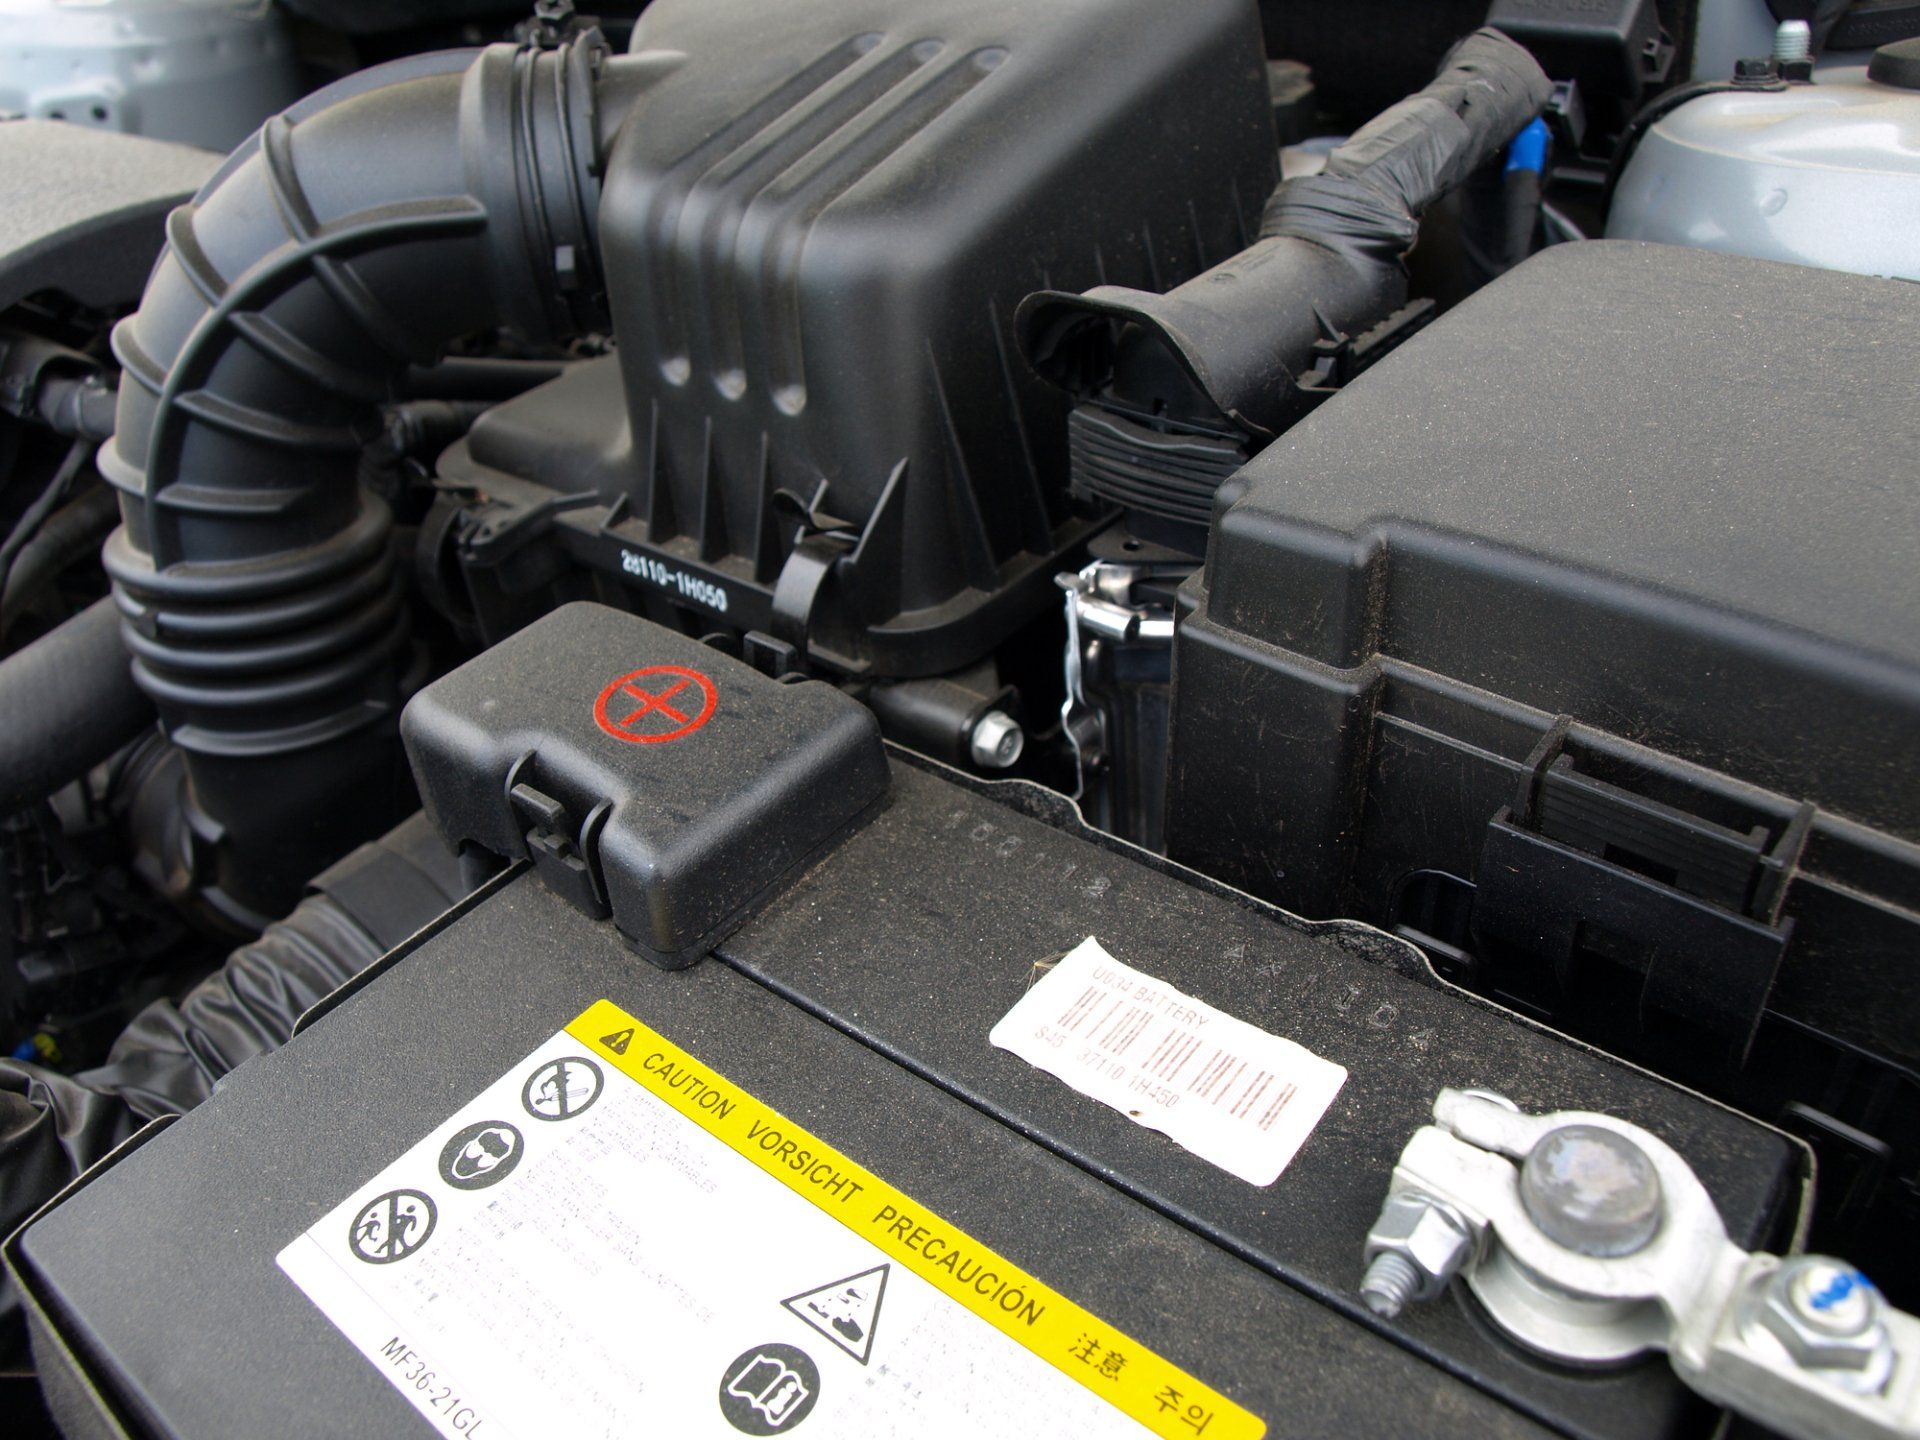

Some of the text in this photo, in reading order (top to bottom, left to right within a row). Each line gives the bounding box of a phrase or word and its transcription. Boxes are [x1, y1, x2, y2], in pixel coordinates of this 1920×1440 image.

[1134, 987, 1209, 1028] BATTERY
[1076, 1049, 1126, 1081] 37110
[643, 1052, 737, 1120] CAUTION
[746, 1119, 864, 1203] VORSICHT
[872, 1204, 1045, 1326] PRECAUCIÓN
[1066, 1332, 1127, 1381] 注意
[1154, 1386, 1214, 1438] 주의
[380, 1336, 483, 1440] MF36-21GL
